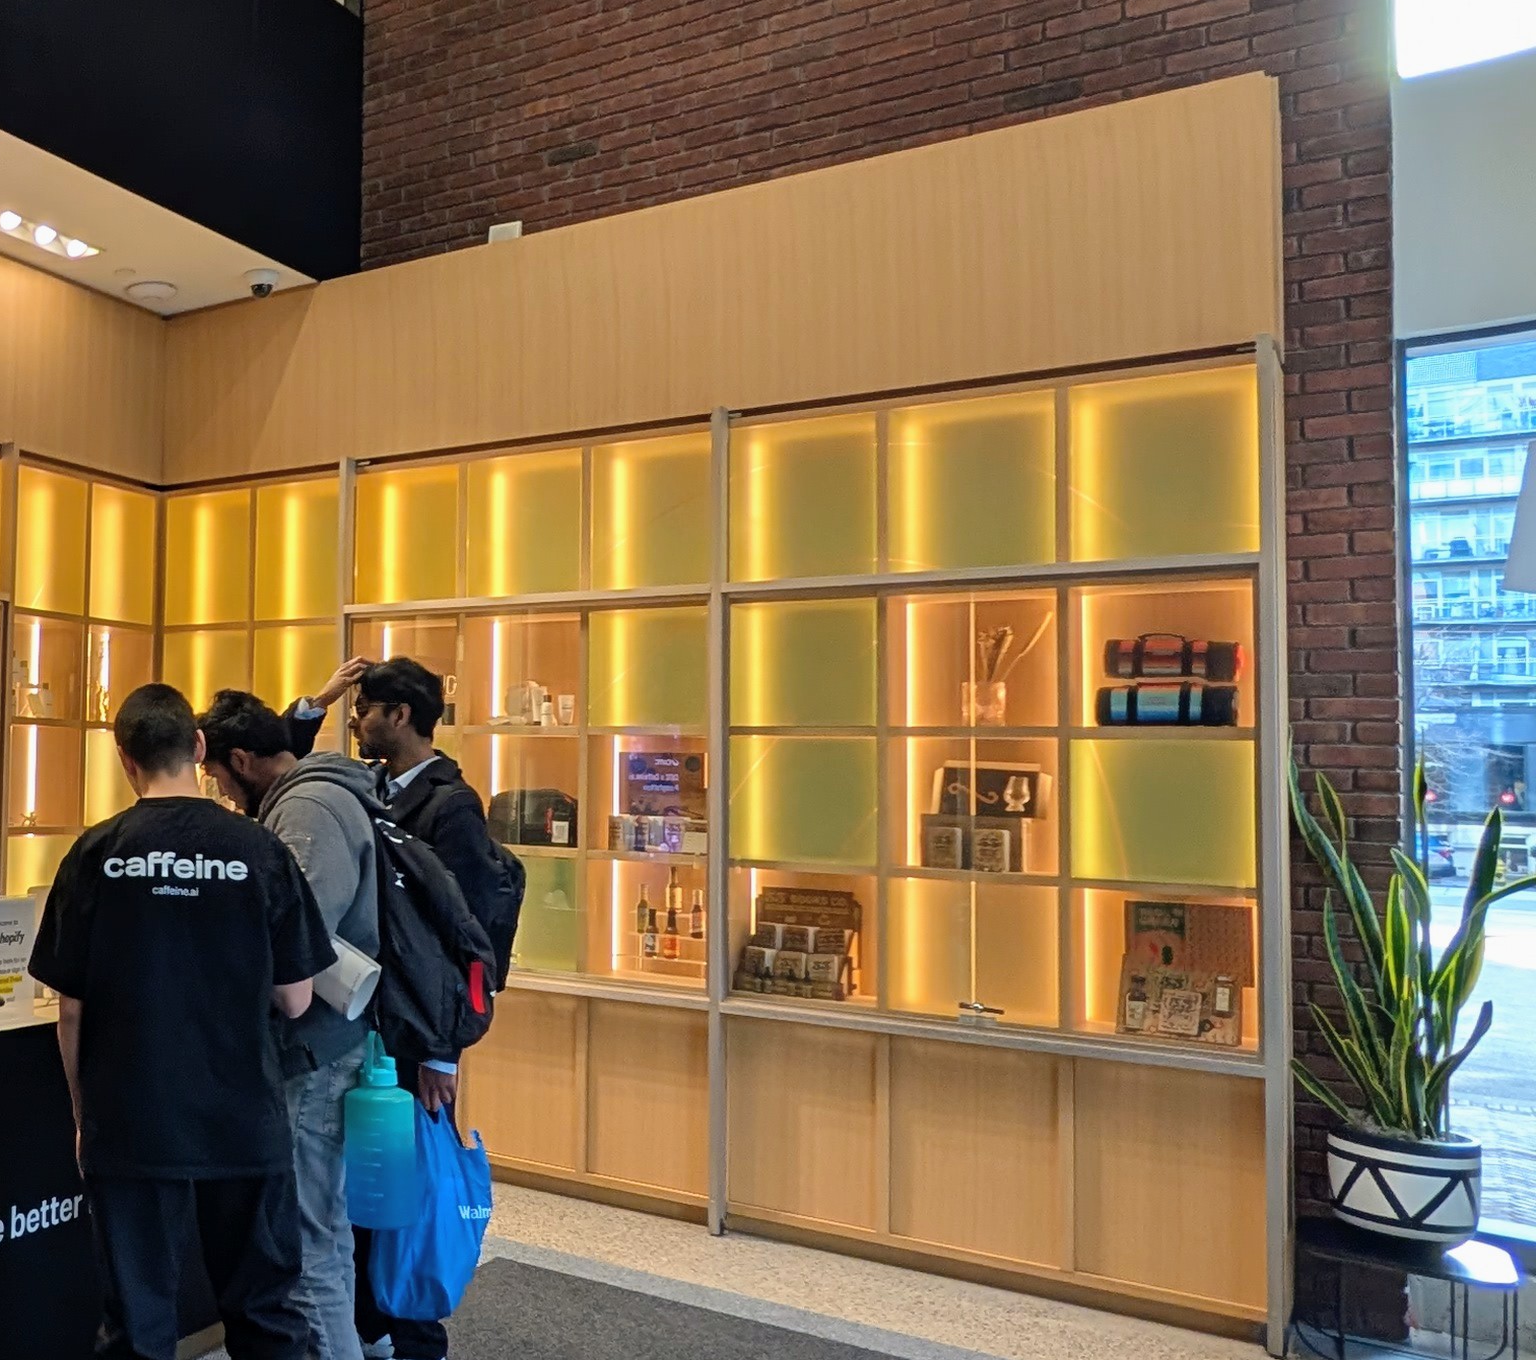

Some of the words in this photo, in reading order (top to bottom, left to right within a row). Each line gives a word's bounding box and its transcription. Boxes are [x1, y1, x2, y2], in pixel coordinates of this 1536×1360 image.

[103, 851, 249, 881] caffeine
[151, 885, 199, 897] caffeine.ai
[10, 1194, 83, 1239] better
